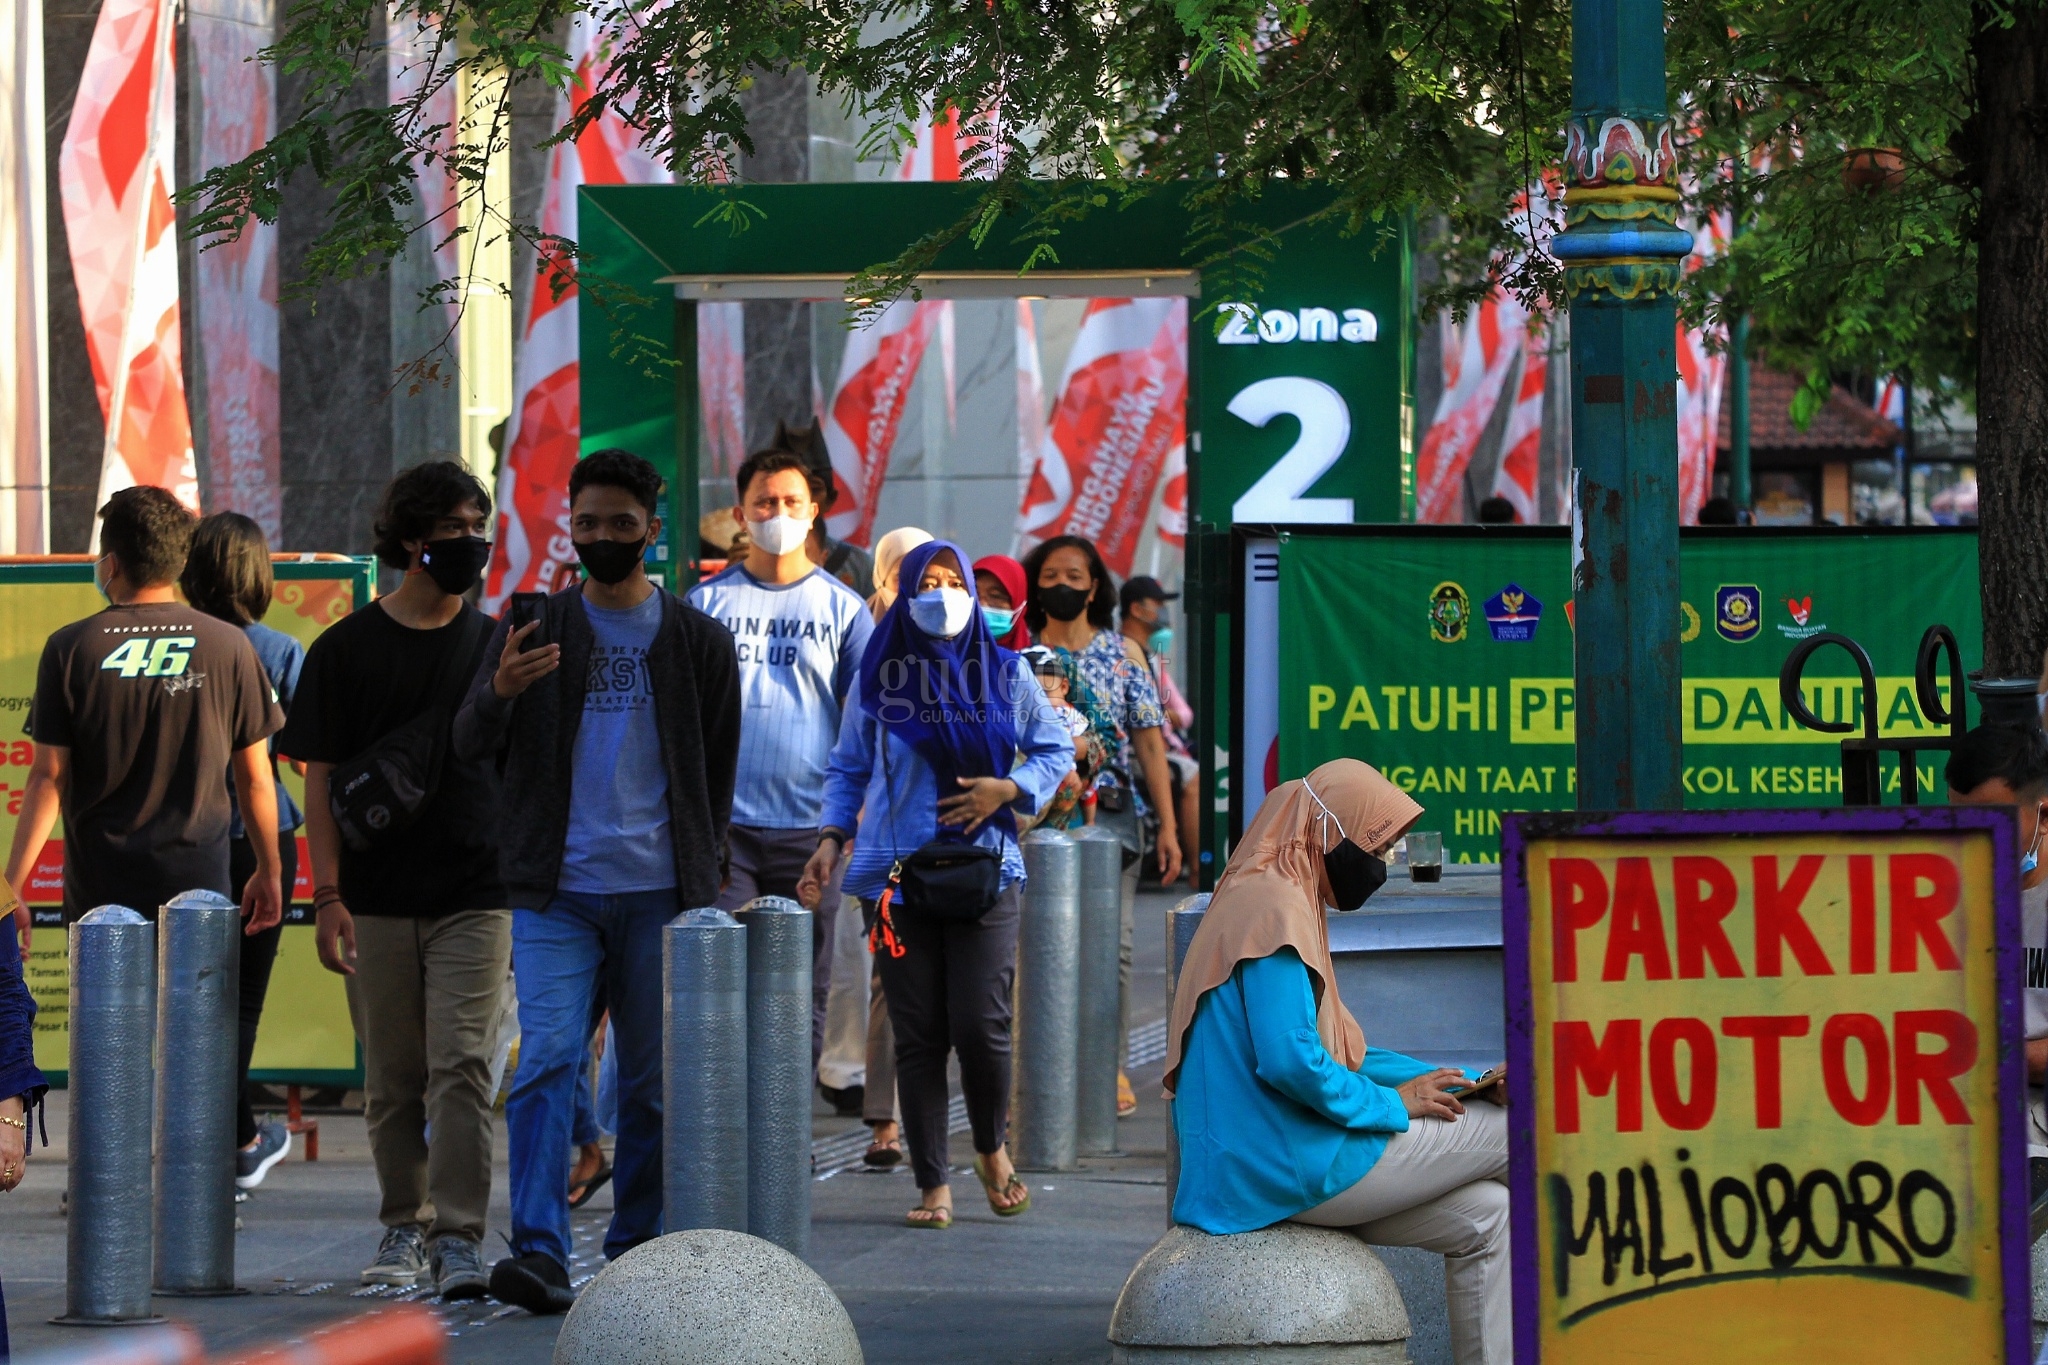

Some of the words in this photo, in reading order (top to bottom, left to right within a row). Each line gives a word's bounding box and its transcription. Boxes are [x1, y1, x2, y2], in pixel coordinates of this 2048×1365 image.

[1216, 302, 1378, 344] Zona
[1084, 376, 1166, 541] NDONESIAKU
[1226, 376, 1355, 523] 2
[726, 616, 832, 642] UNAWAY
[100, 636, 197, 678] 46
[611, 646, 627, 655] BE
[738, 643, 798, 666] CLUB
[585, 696, 648, 704] ALATIGA
[1308, 685, 1498, 732] PATUHI
[1521, 687, 1575, 731] PP
[1476, 766, 1557, 793] TAAT
[1750, 766, 1935, 794] KESEHAN
[1548, 853, 1964, 983] PARKIR
[1551, 1009, 1979, 1134] MOTOR
